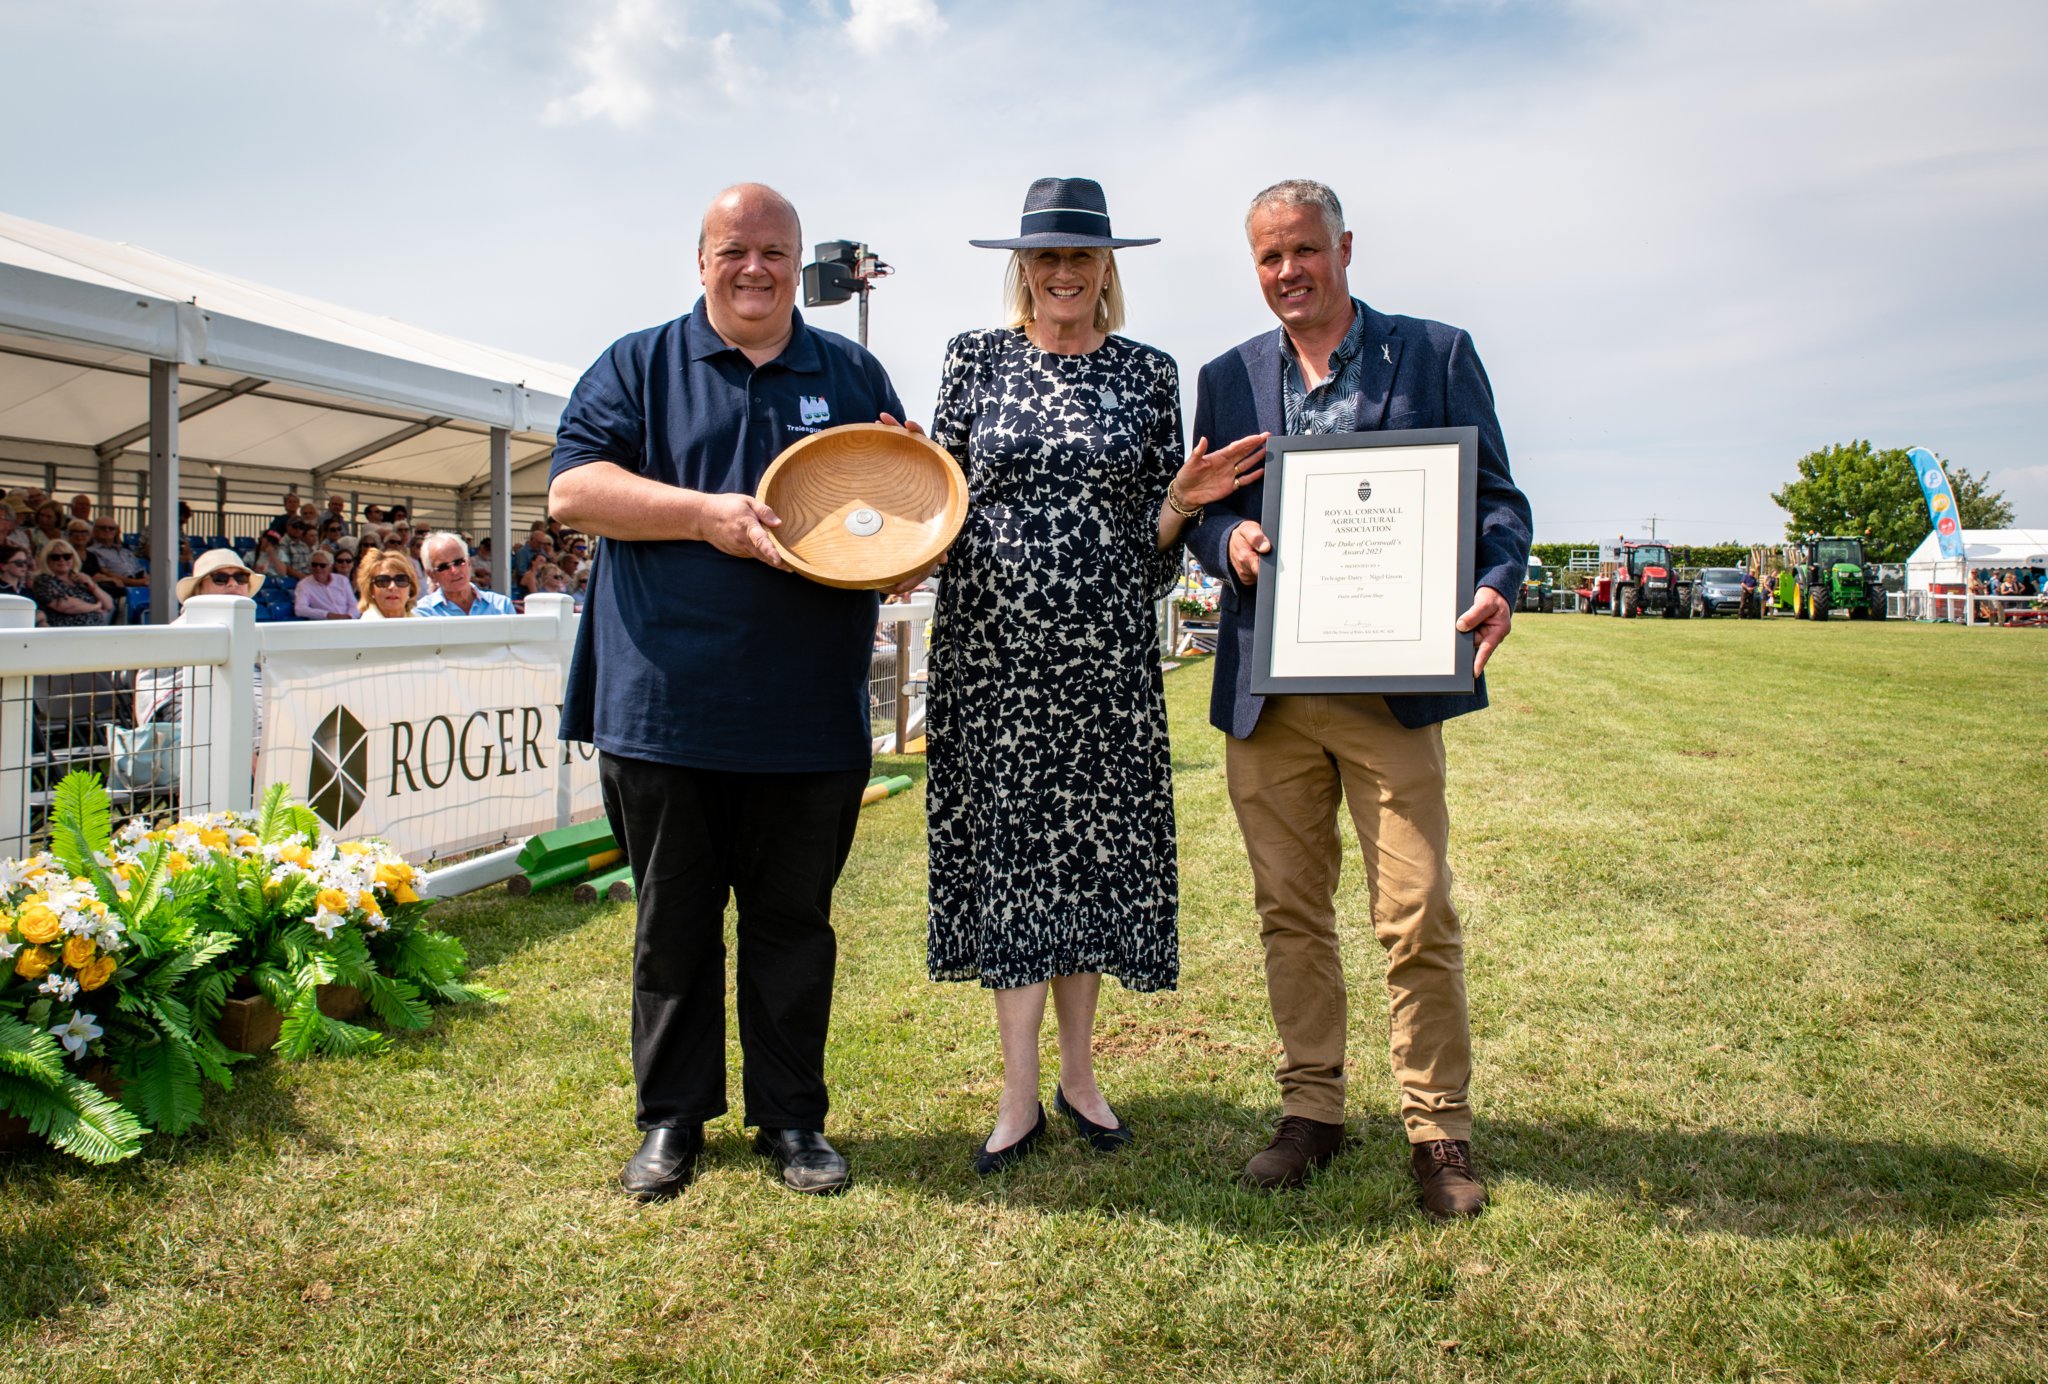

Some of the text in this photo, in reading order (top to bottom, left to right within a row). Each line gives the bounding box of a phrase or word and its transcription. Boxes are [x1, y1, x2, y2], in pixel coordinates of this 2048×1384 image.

[1355, 507, 1403, 515] CORNWALL
[1331, 516, 1396, 525] AGRICULTURAL
[1335, 525, 1391, 533] ASSOCIATION
[1365, 539, 1402, 547] Cornwall's
[1343, 548, 1365, 556] Award
[387, 706, 548, 798] ROGER
